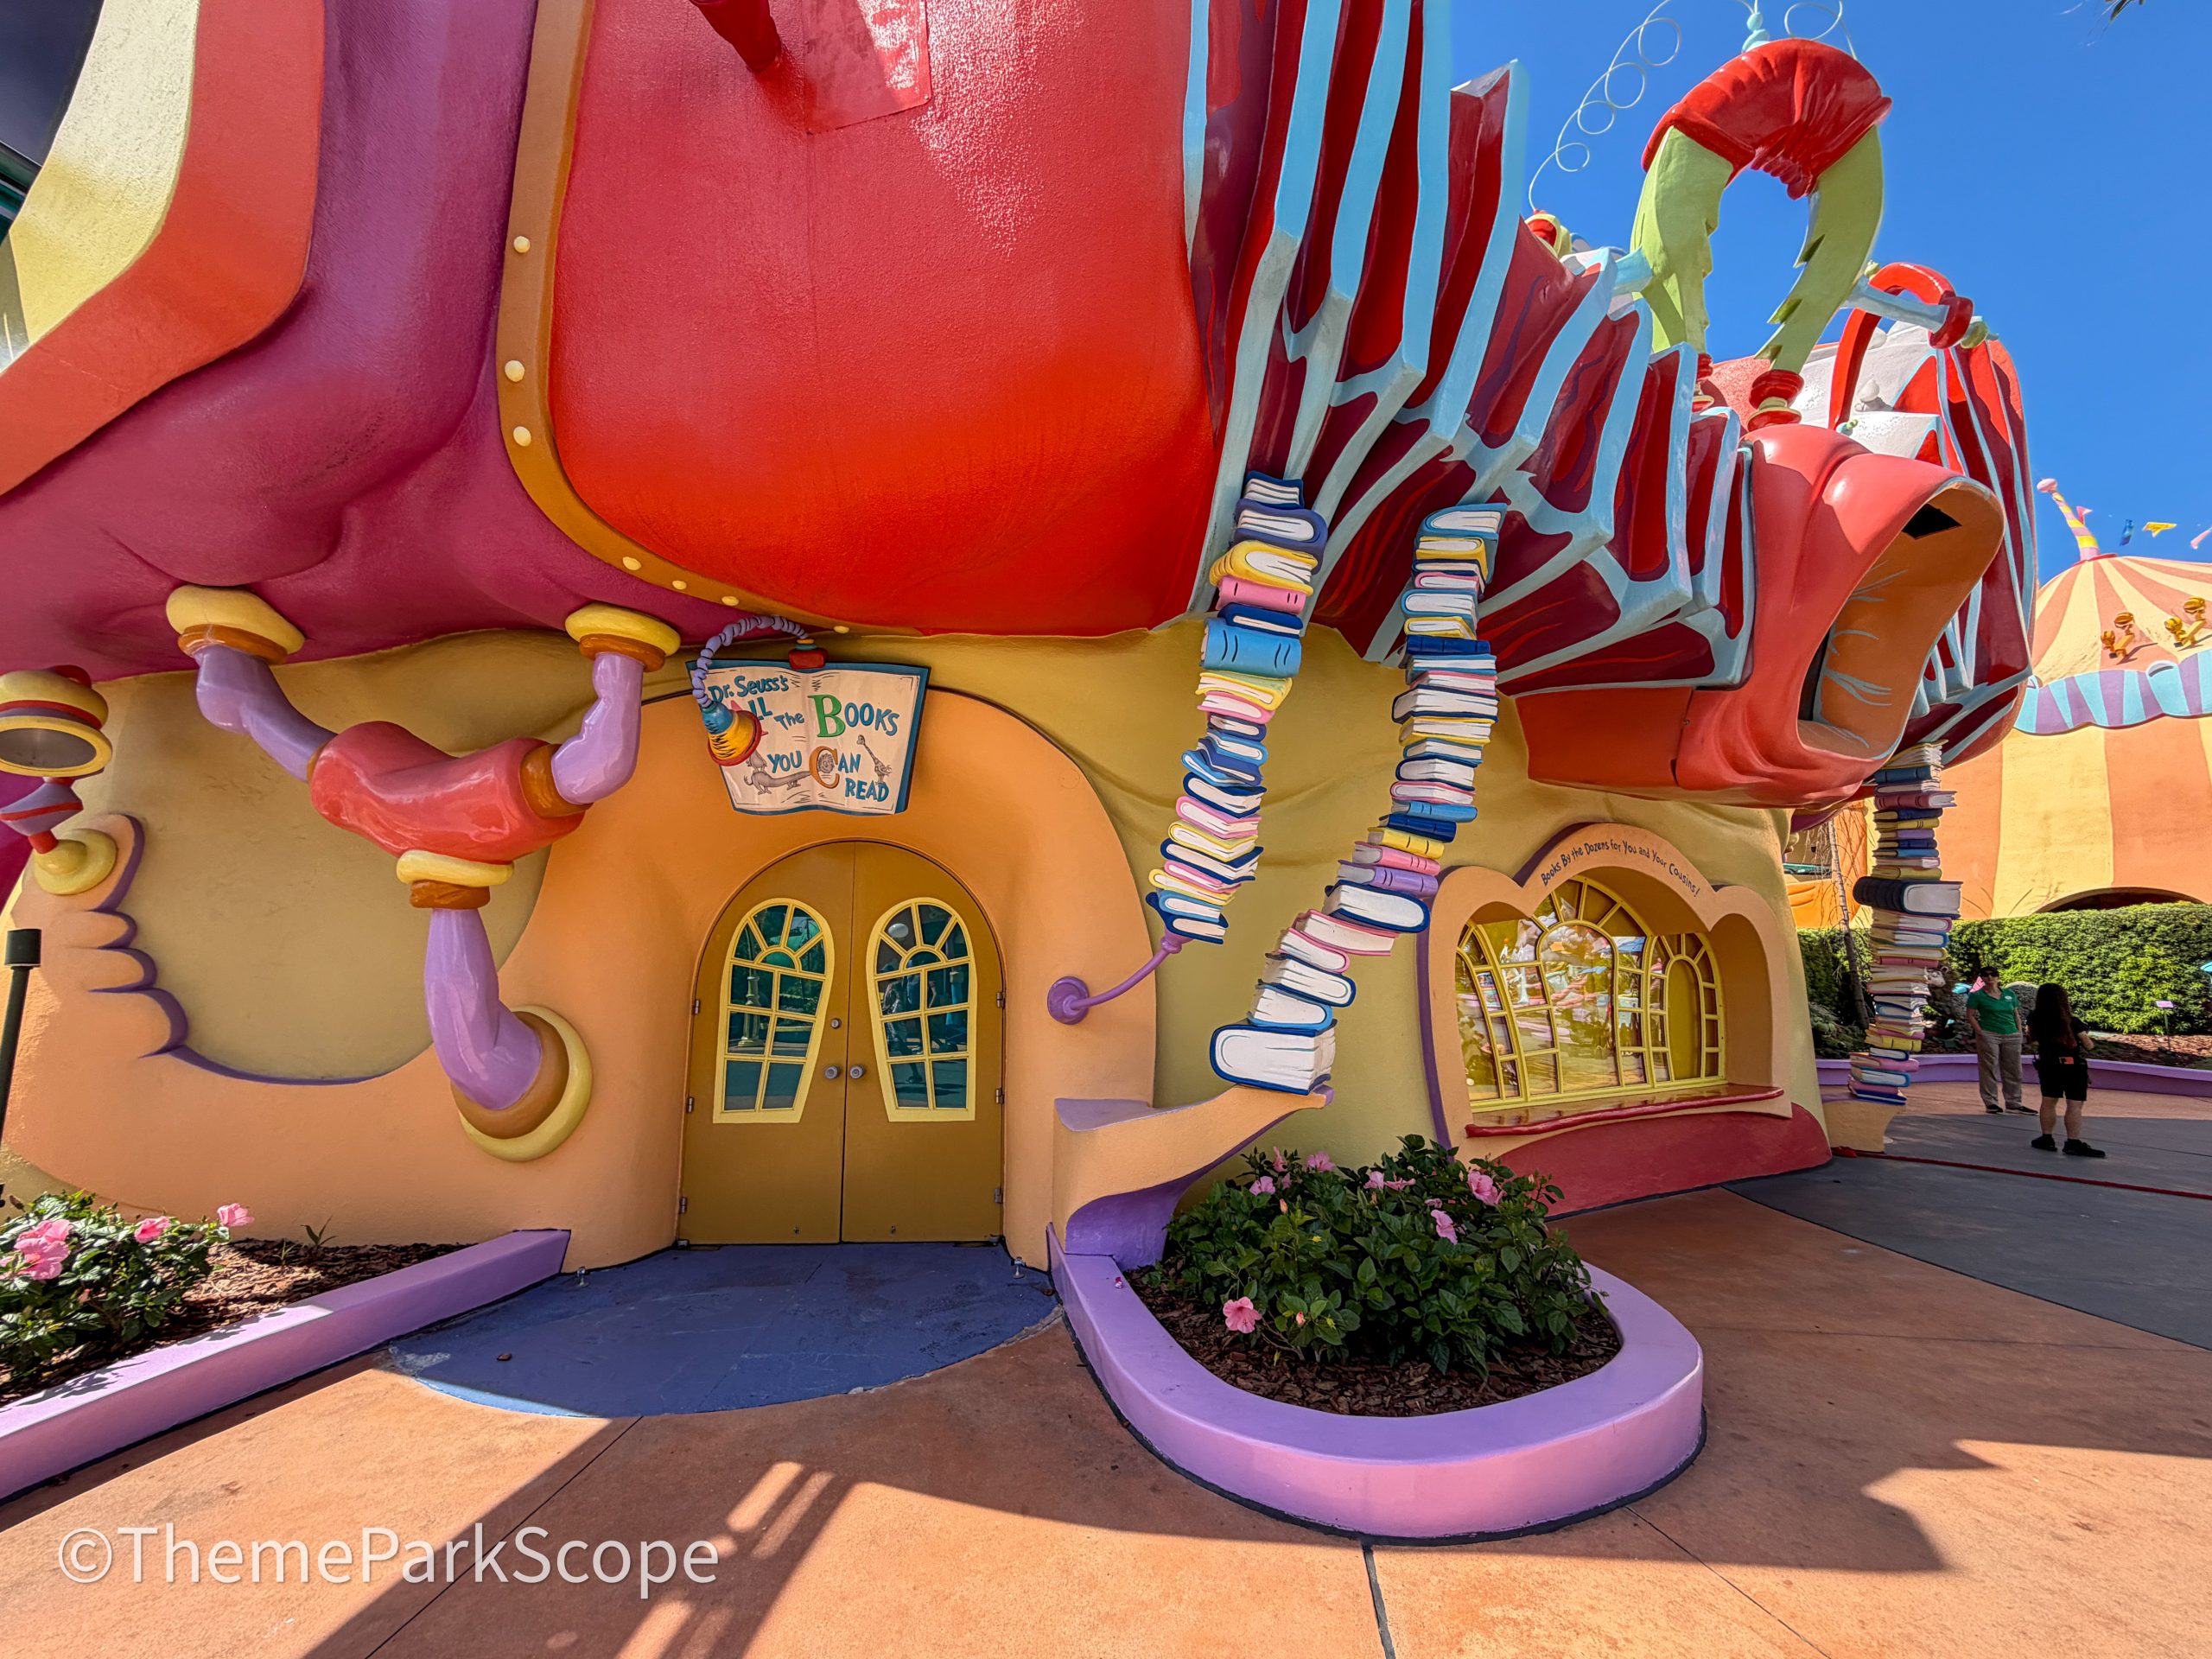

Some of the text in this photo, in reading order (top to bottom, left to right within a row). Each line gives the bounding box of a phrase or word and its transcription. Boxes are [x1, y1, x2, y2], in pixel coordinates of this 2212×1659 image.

[708, 675, 790, 703] Dr. Seuss's
[730, 694, 899, 738] LL The BOOKS
[767, 746, 861, 789] YOU CAN
[845, 777, 890, 802] READ
[1541, 839, 1700, 897] Books By the Dozens for You and Your Cousins!
